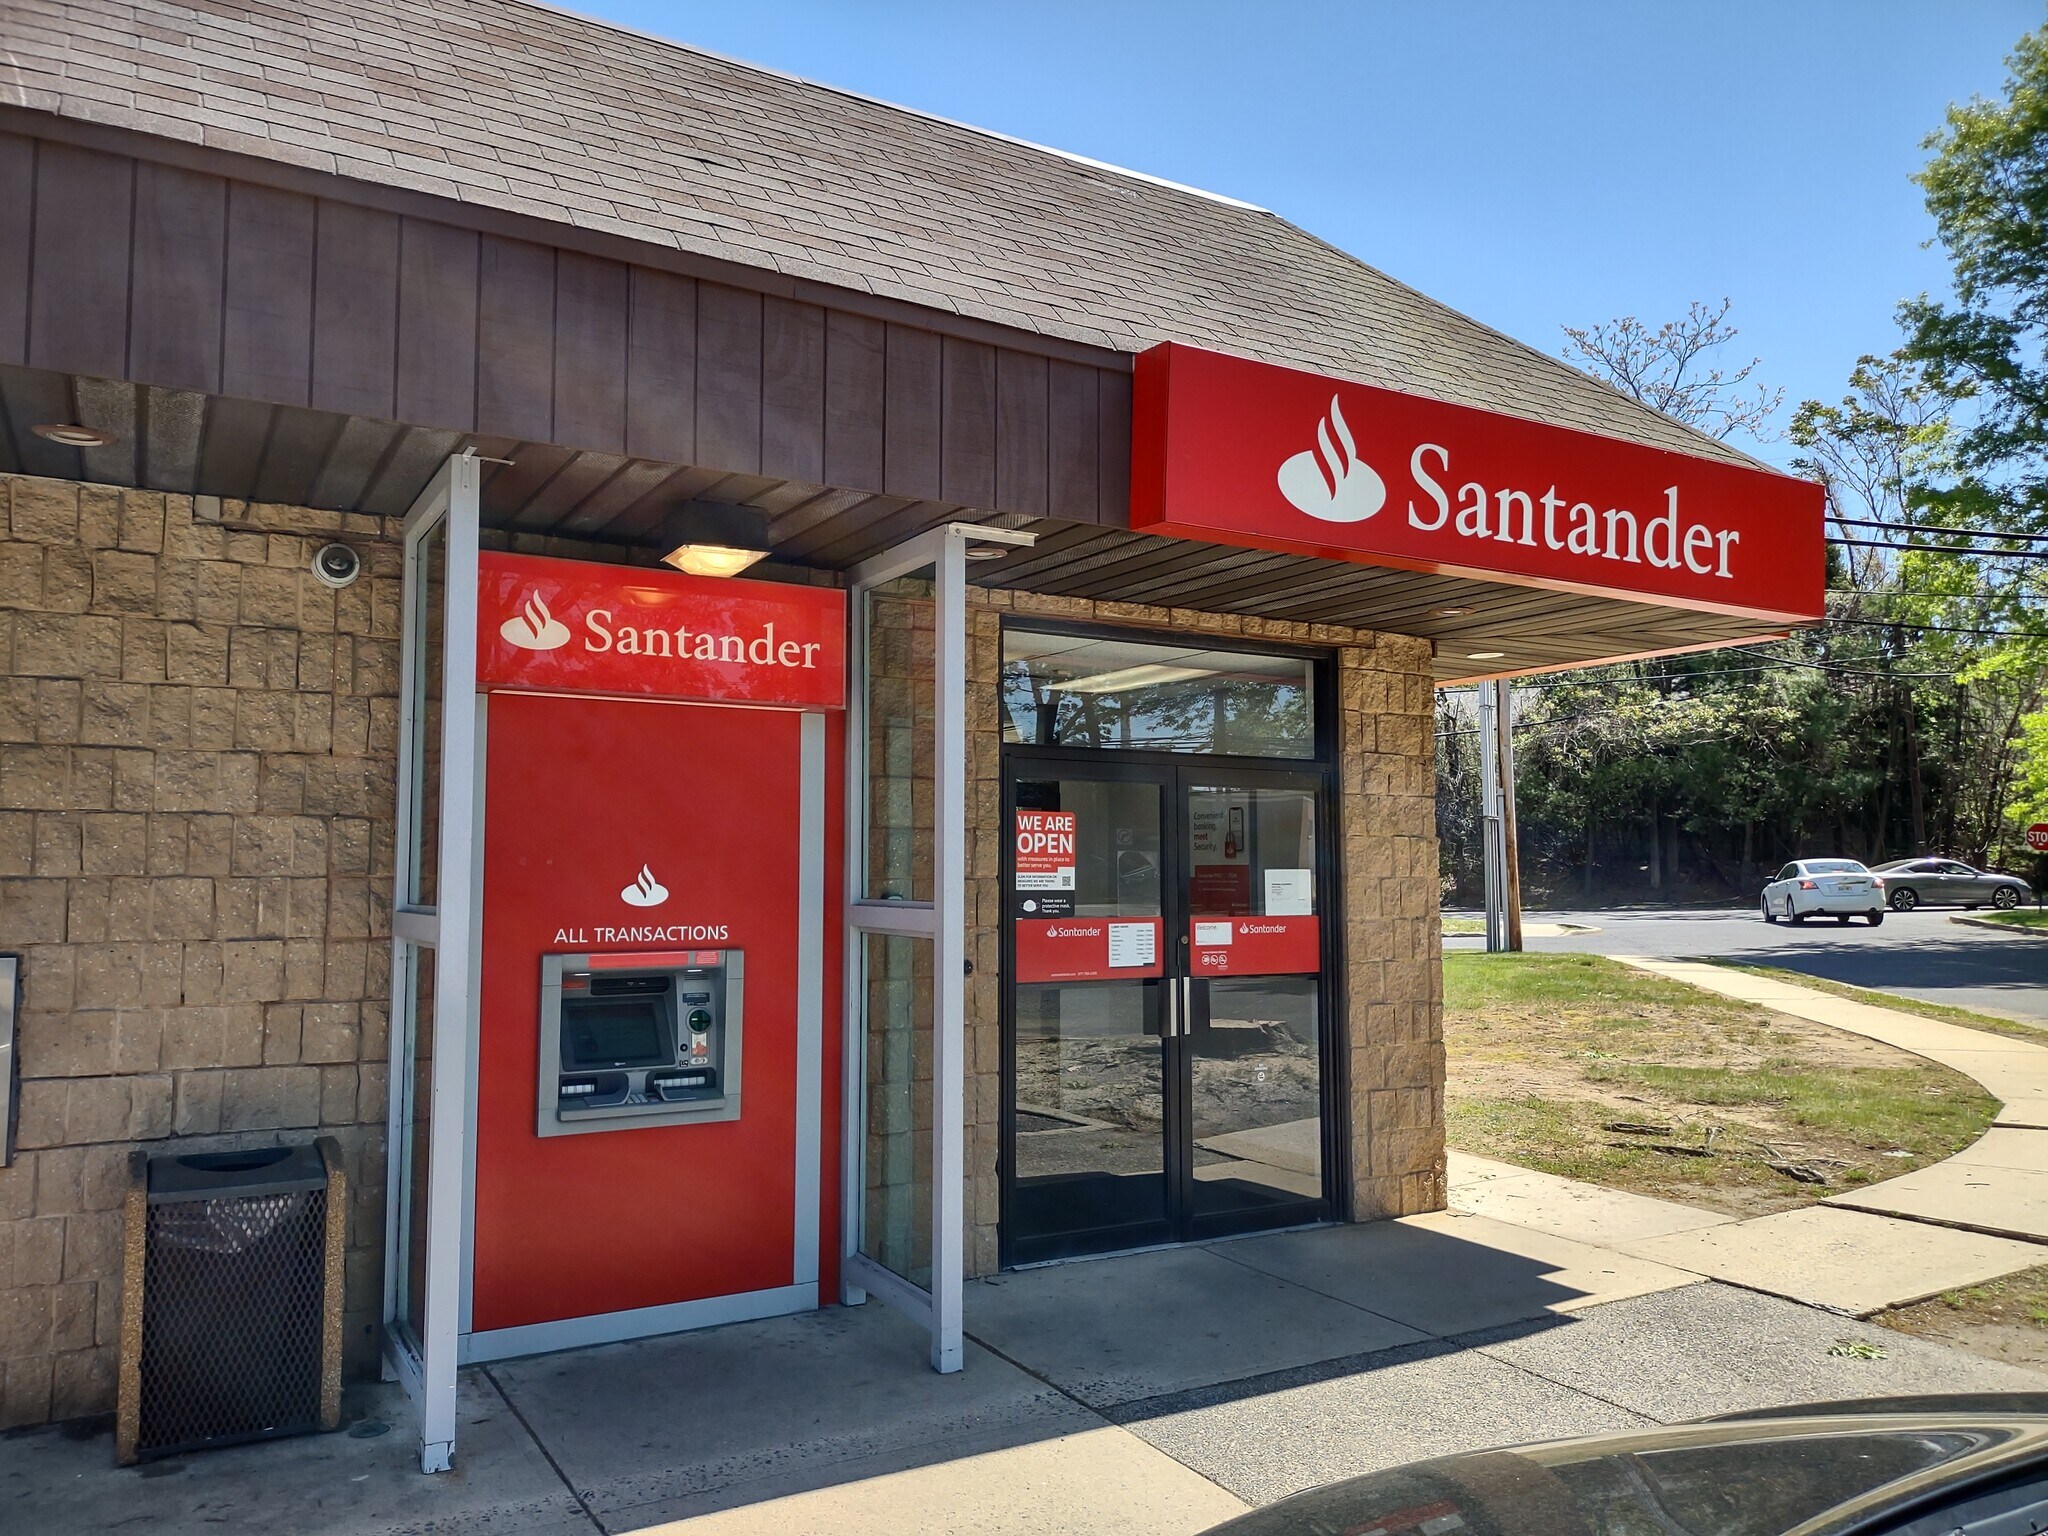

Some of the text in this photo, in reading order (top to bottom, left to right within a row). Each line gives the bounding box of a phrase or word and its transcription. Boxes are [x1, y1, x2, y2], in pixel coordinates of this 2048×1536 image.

[1407, 442, 1740, 579] Santander
[584, 608, 820, 669] Santander
[1193, 811, 1224, 820] Convenient
[1017, 815, 1073, 831] WE ARE
[1017, 832, 1073, 854] OPEN
[1193, 832, 1208, 841] meet
[2027, 831, 2048, 843] STO
[553, 925, 729, 944] ALL TRANSACTIONS
[1058, 926, 1101, 937] Santander
[1249, 924, 1287, 934] Santander
